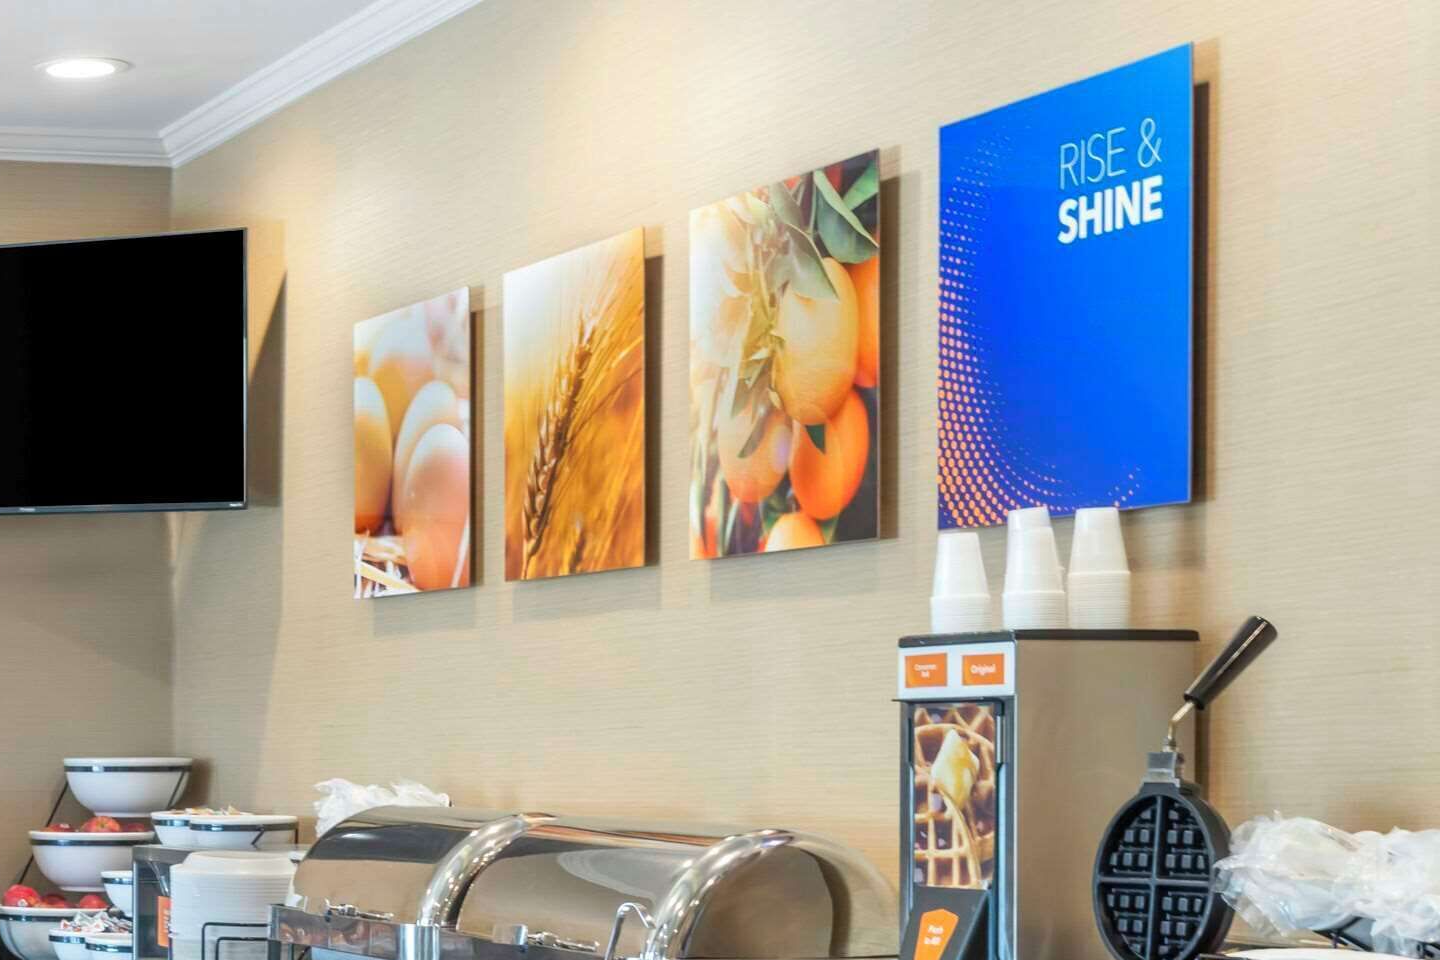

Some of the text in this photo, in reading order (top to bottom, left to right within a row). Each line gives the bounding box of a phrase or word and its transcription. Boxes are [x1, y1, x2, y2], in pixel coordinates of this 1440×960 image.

[1060, 117, 1162, 190] RISE &
[1057, 174, 1164, 244] SHINE
